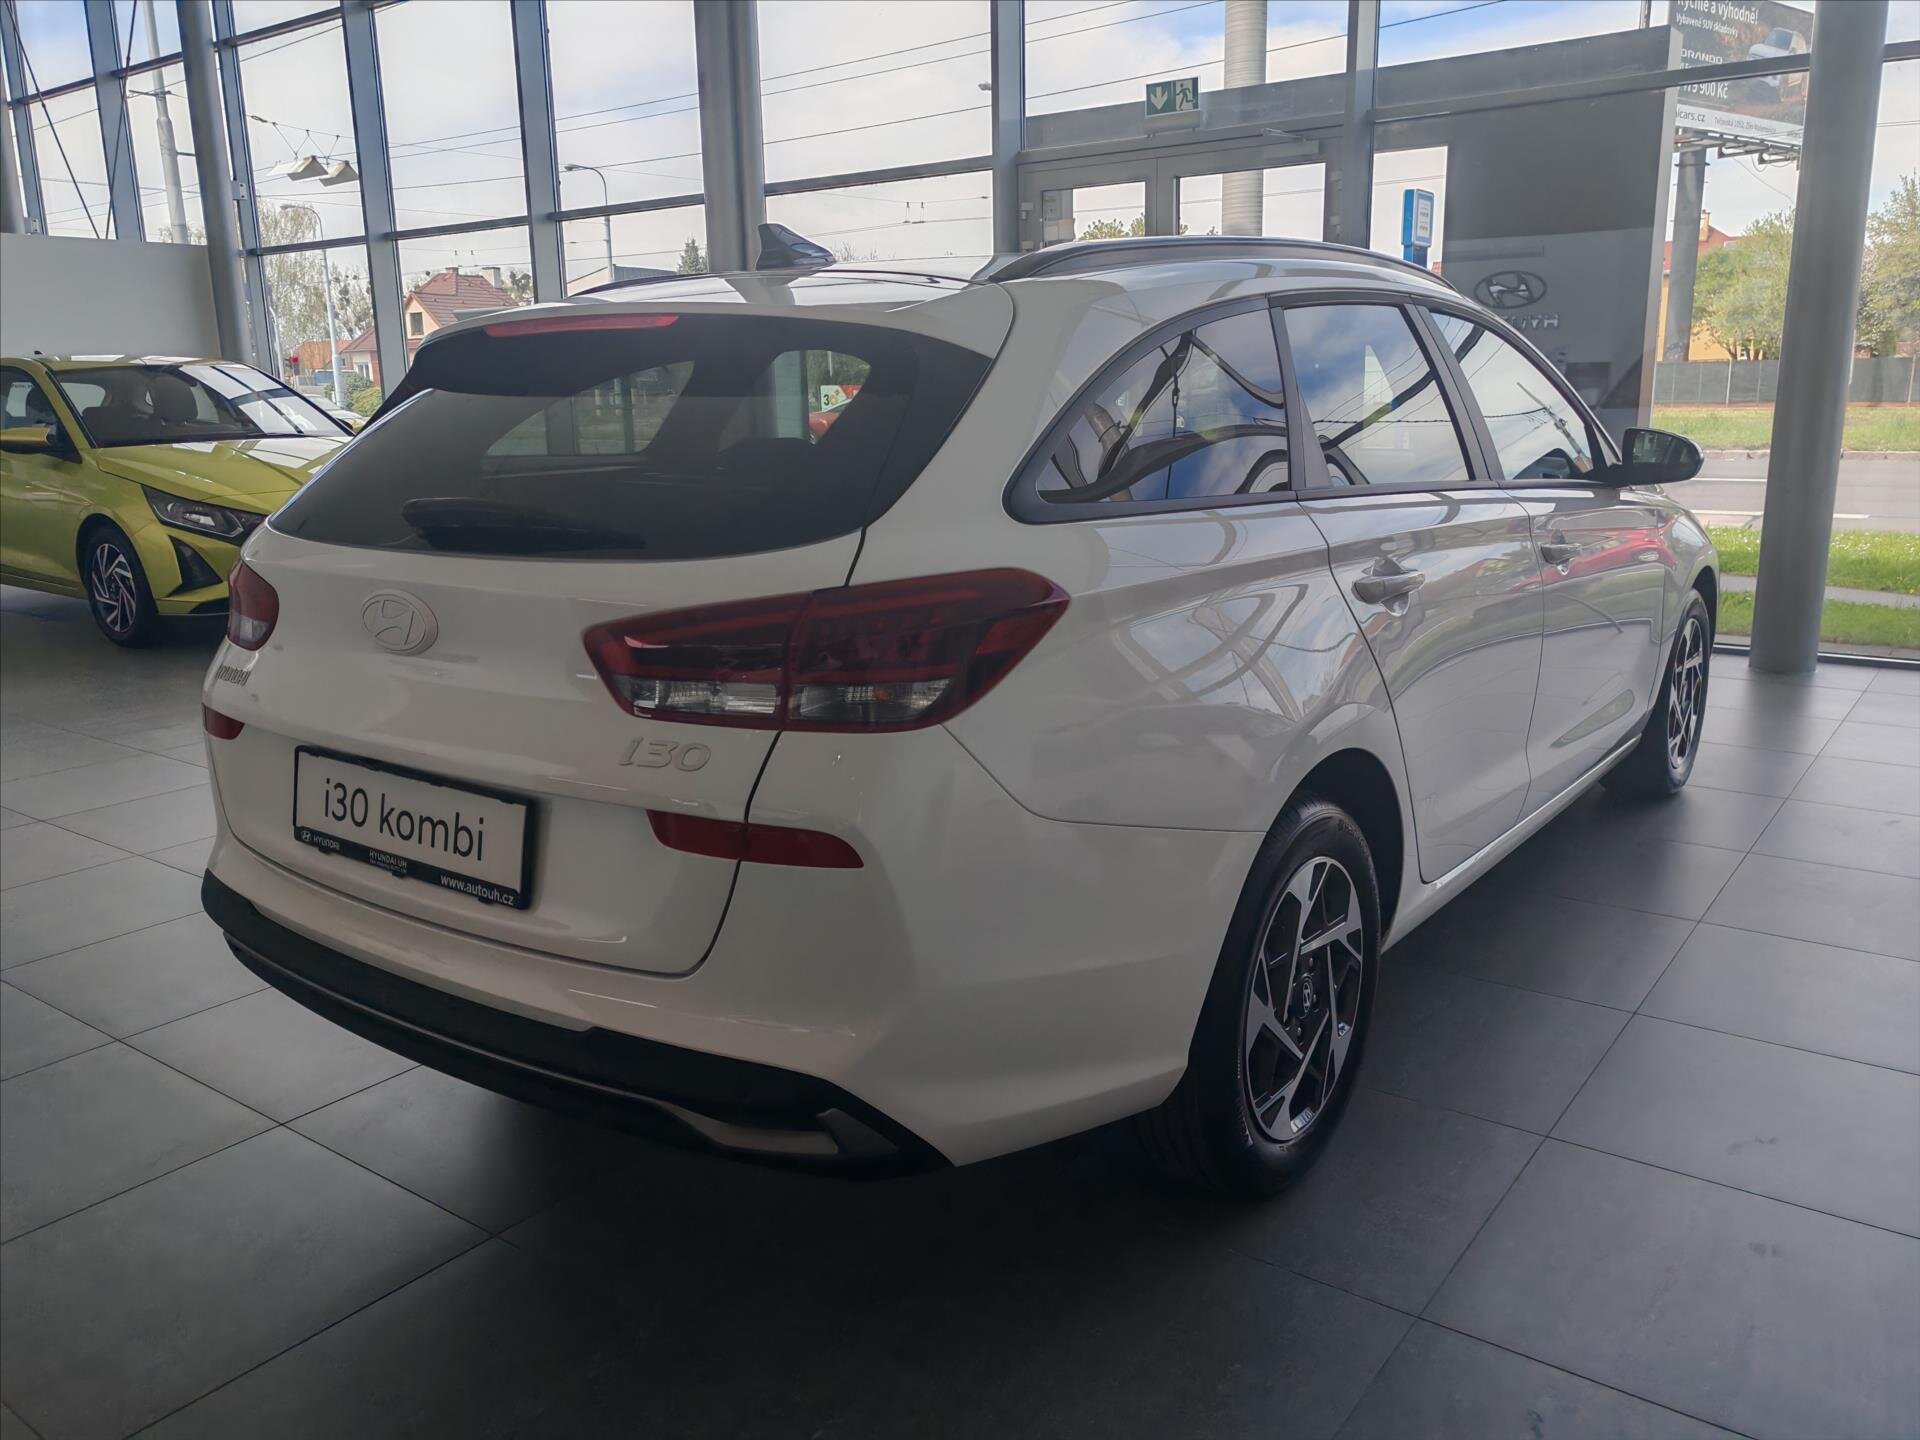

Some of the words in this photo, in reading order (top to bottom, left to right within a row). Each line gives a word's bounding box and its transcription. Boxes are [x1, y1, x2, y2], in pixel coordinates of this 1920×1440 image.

[1702, 19, 1713, 30] SUV
[1710, 1, 1716, 14] a
[1718, 0, 1760, 25] výhodně!
[1717, 81, 1729, 99] Kč
[618, 736, 711, 772] i30
[324, 778, 369, 827] i30
[379, 793, 485, 861] kombi
[440, 874, 515, 906] www.autouh.cz
